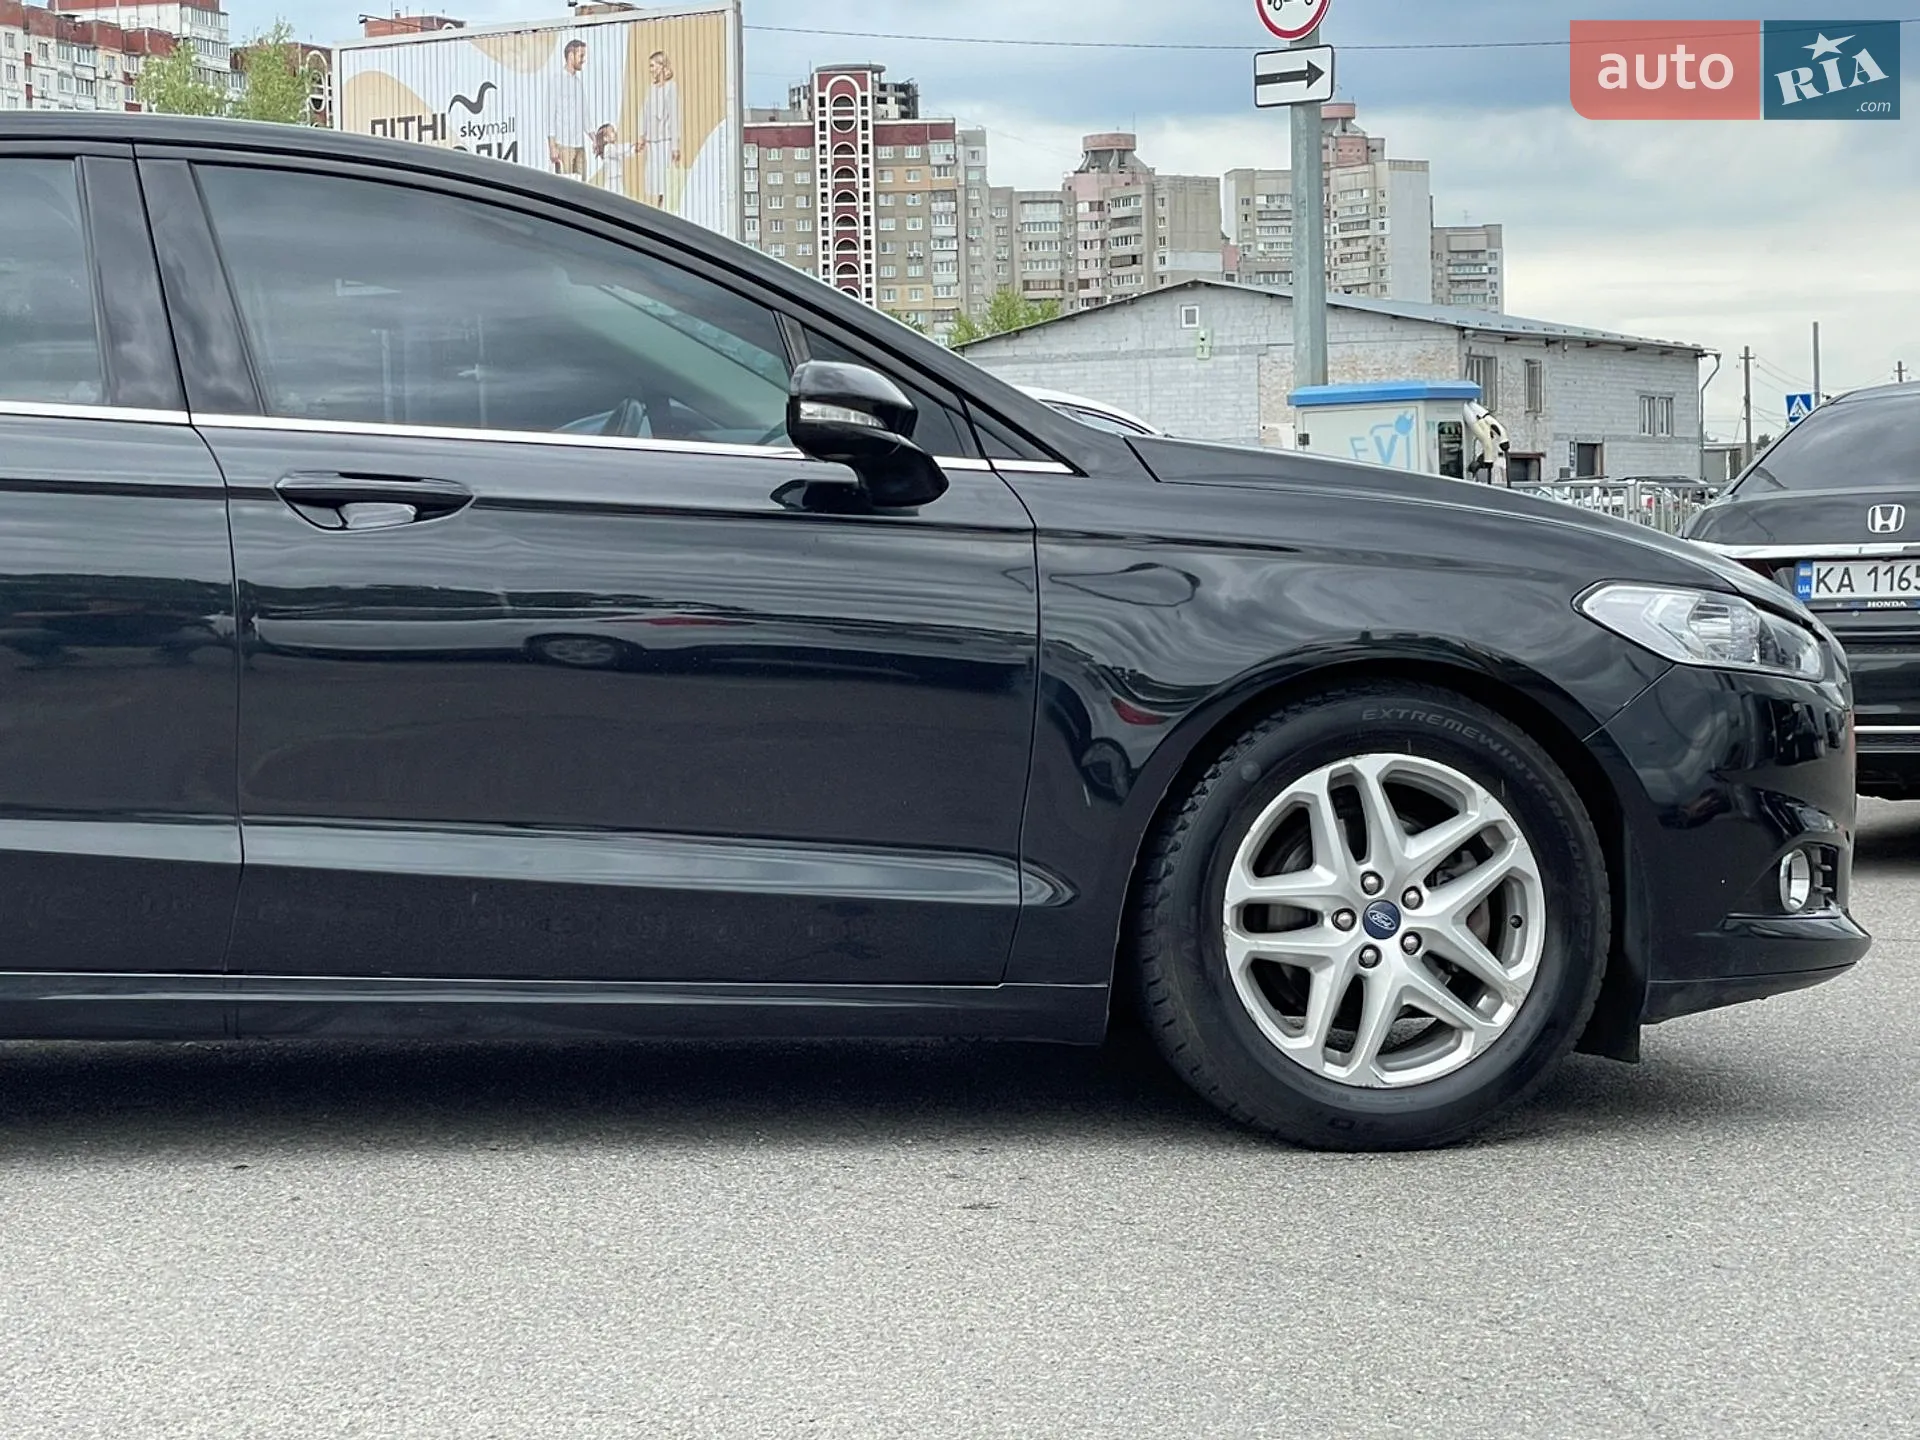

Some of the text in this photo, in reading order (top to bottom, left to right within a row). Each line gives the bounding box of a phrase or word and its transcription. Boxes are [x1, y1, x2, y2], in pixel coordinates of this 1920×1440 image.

[460, 117, 515, 140] skymall
[1797, 584, 1811, 594] UA
[1816, 566, 1855, 593] KA
